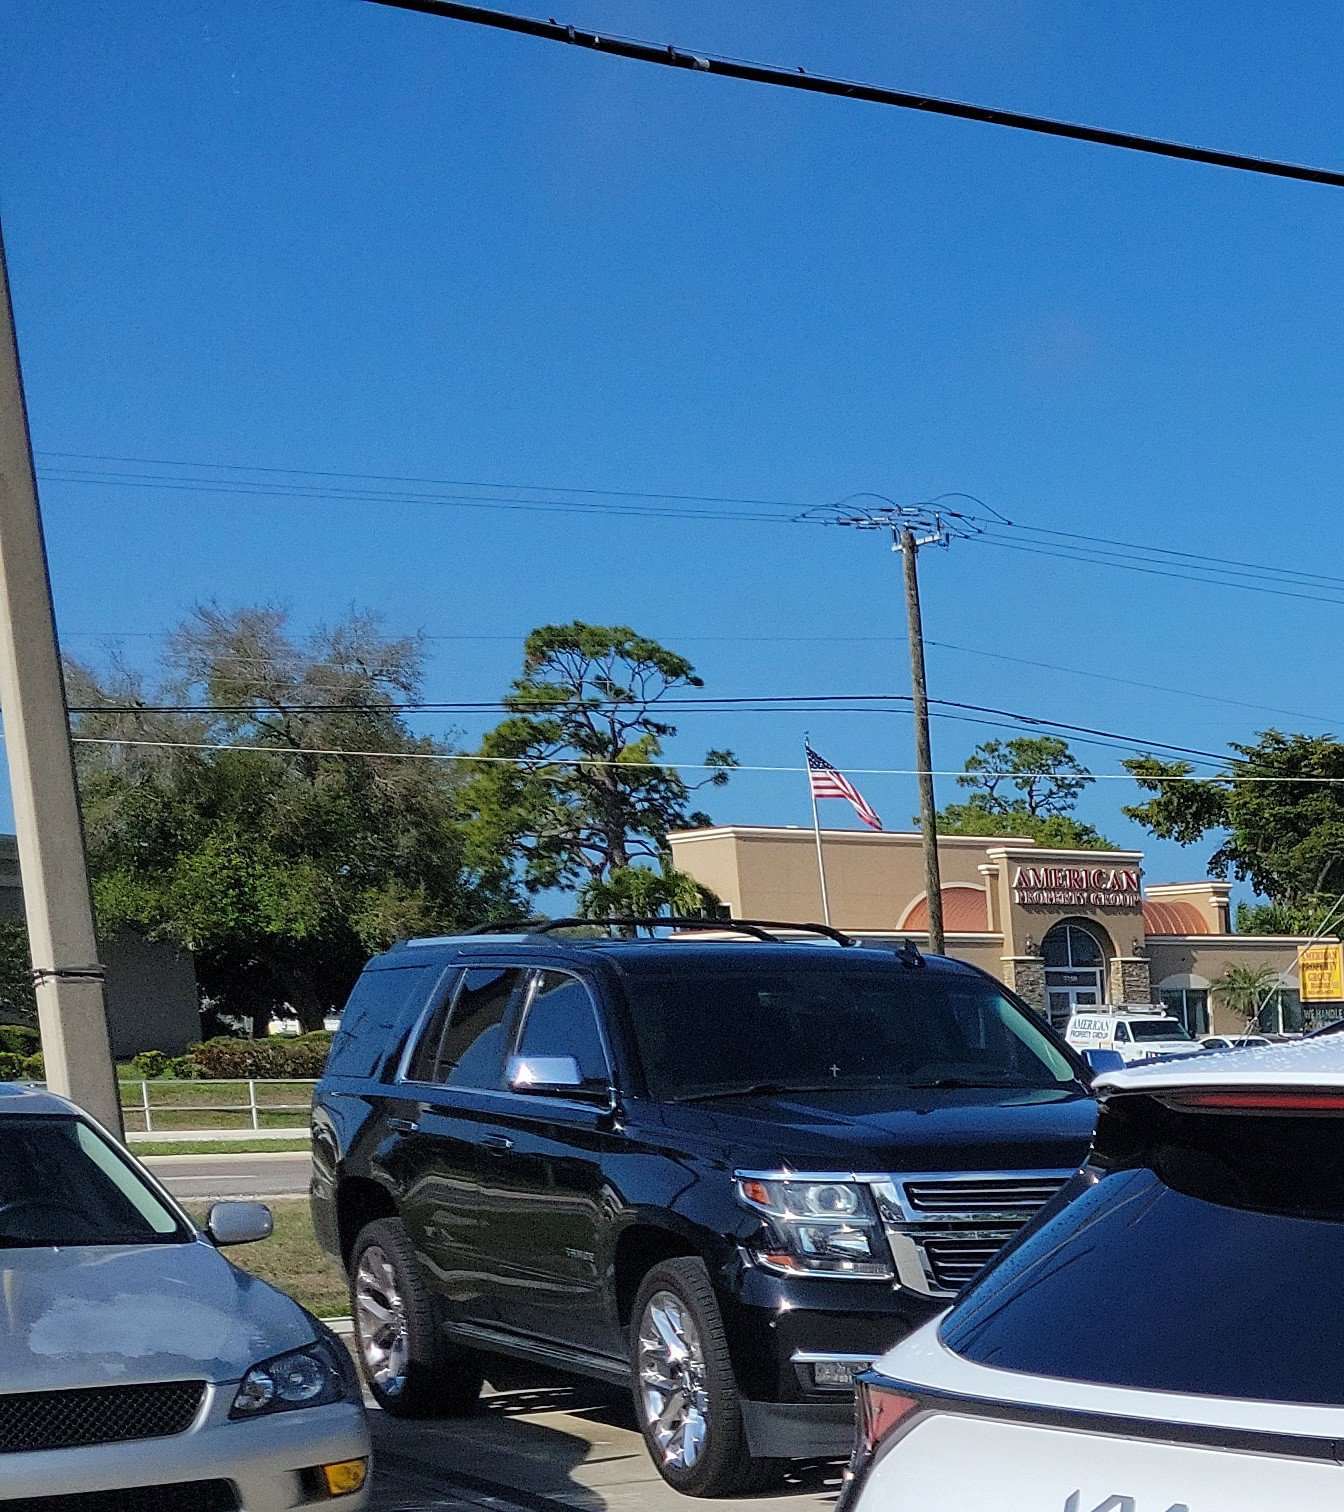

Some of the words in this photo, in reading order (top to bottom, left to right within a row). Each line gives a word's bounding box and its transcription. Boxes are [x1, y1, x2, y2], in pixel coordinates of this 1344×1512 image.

[1012, 866, 1138, 891] AMERICAN
[1014, 890, 1088, 904] PROPERTY
[1090, 892, 1139, 906] GROUP
[1072, 1018, 1111, 1031] AMERICAN
